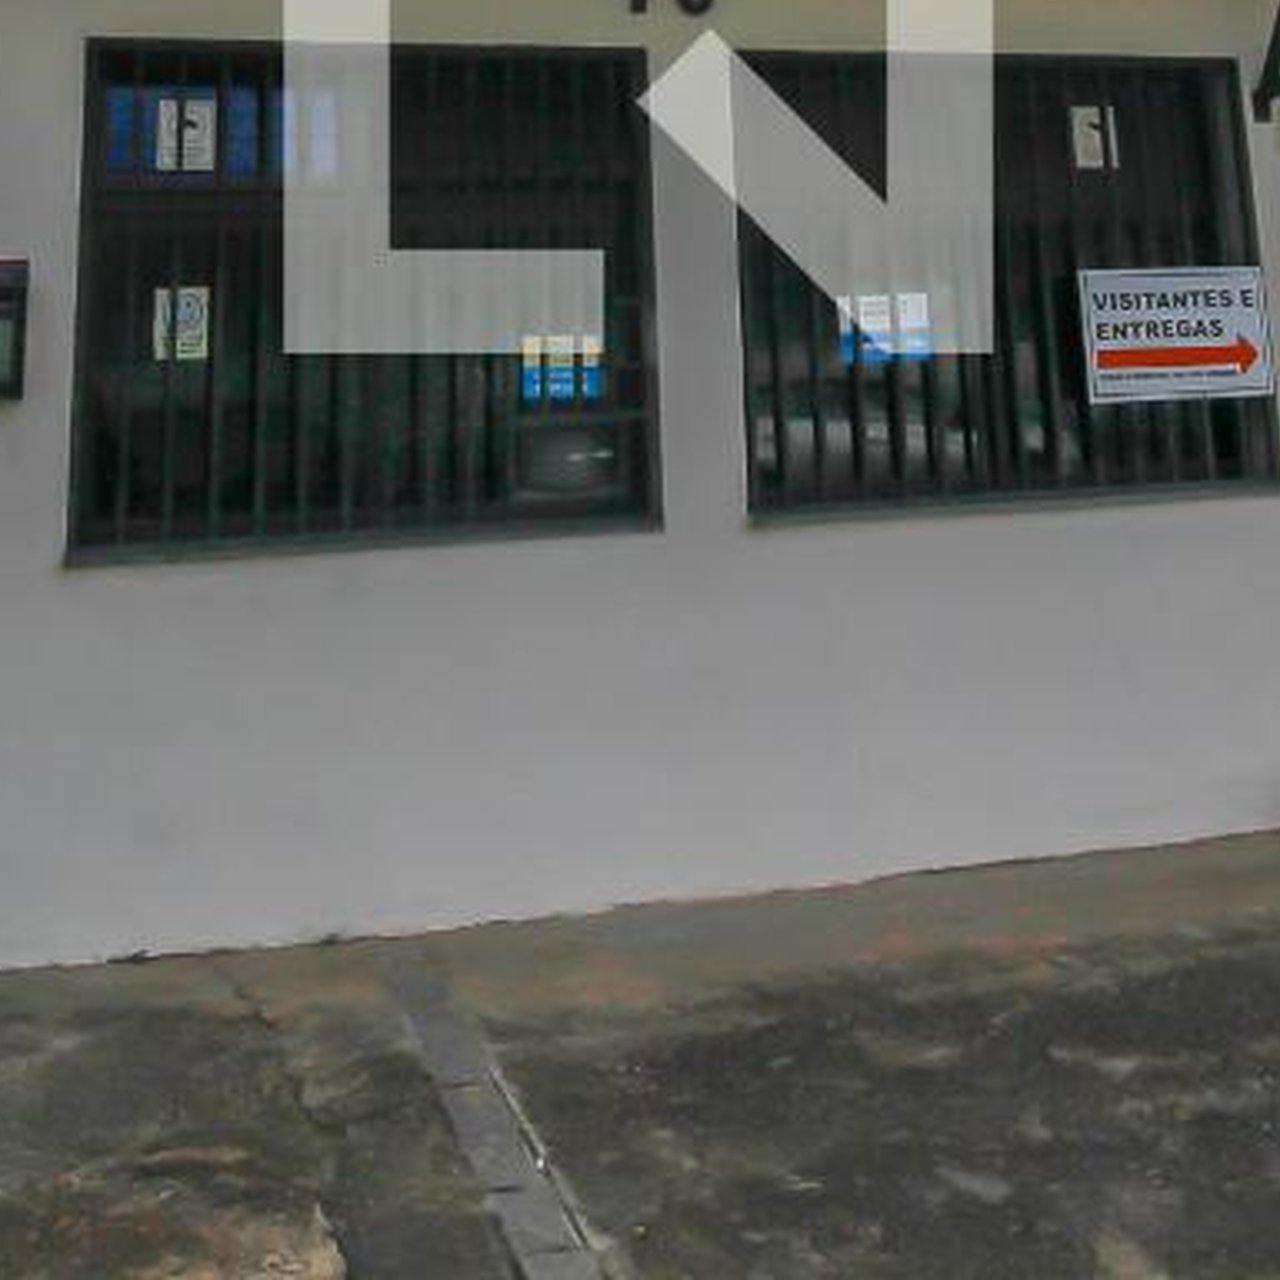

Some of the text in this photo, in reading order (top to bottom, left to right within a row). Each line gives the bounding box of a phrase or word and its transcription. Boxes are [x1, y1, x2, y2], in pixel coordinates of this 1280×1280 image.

[1092, 288, 1255, 311] VISITANTES E
[1096, 319, 1225, 341] ENTREGAS
